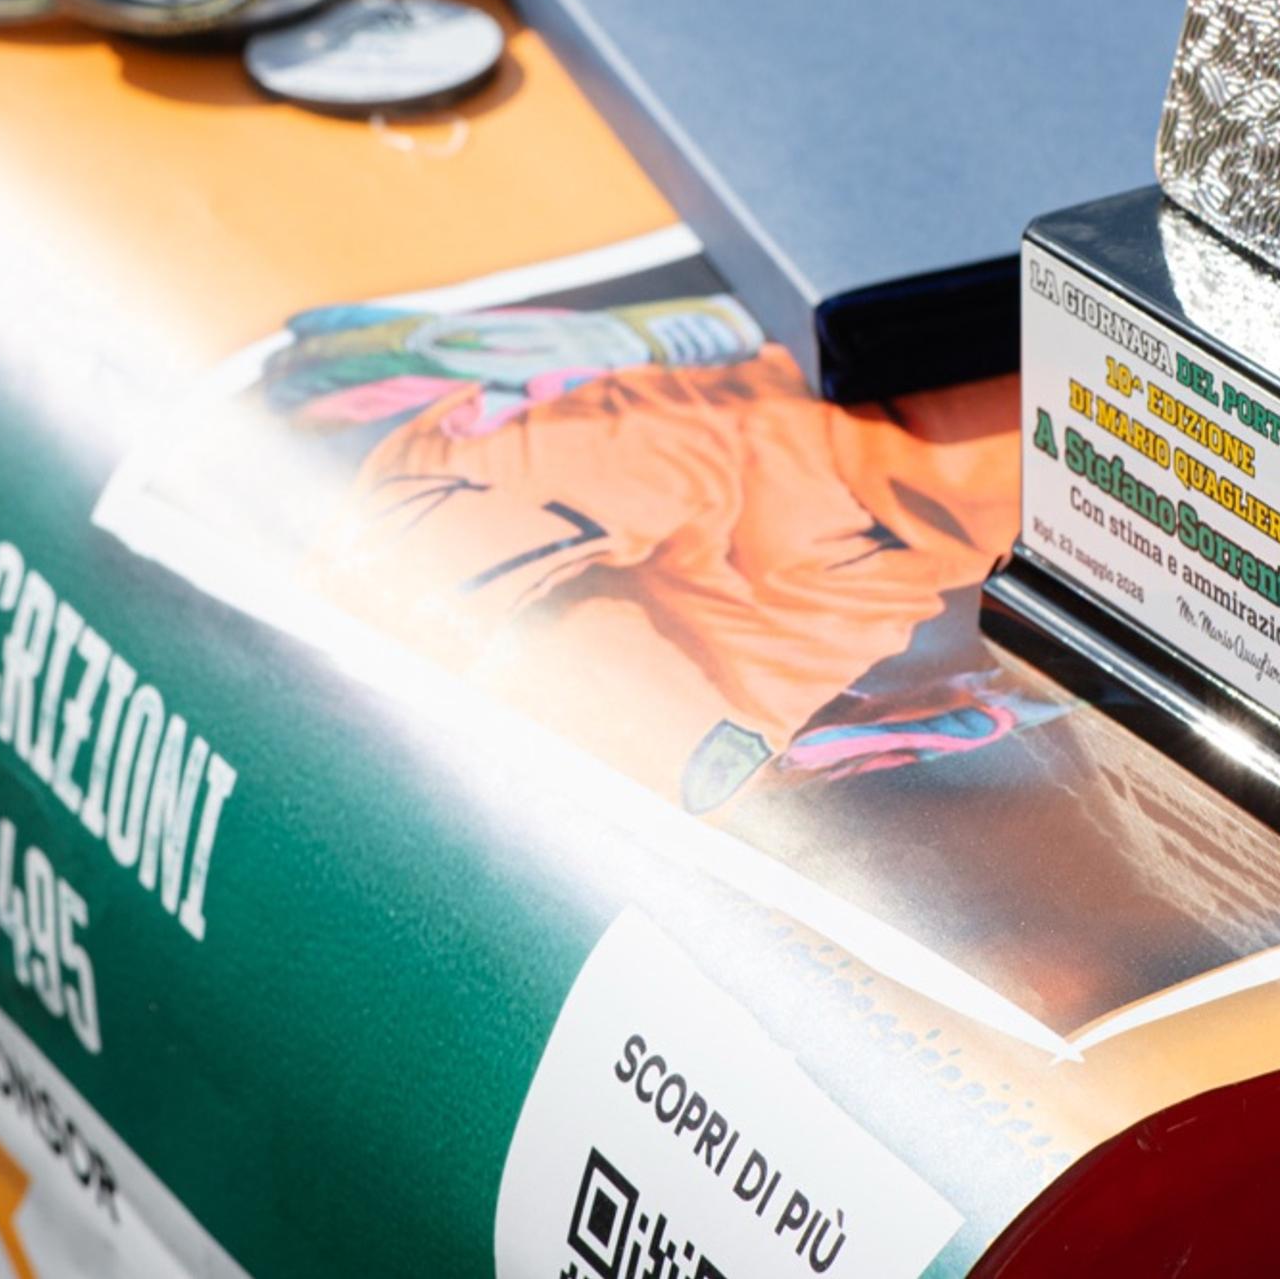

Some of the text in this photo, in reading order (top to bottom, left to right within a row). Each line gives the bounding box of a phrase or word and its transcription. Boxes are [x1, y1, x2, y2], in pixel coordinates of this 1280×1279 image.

[1030, 259, 1060, 306] LA
[1062, 281, 1173, 378] GIORNATA
[1176, 351, 1220, 408] DEL
[1033, 406, 1059, 460] A
[1064, 426, 1176, 538] Stefano
[1068, 377, 1094, 421] DI
[1095, 396, 1171, 470] MARIO
[1147, 380, 1256, 479] EDIZIONE
[1070, 485, 1105, 528] Con
[1109, 516, 1163, 567] stima
[1167, 553, 1178, 575] e
[1074, 547, 1115, 583] maggio
[614, 1033, 848, 1275] SCOPRI DI PIÙ
